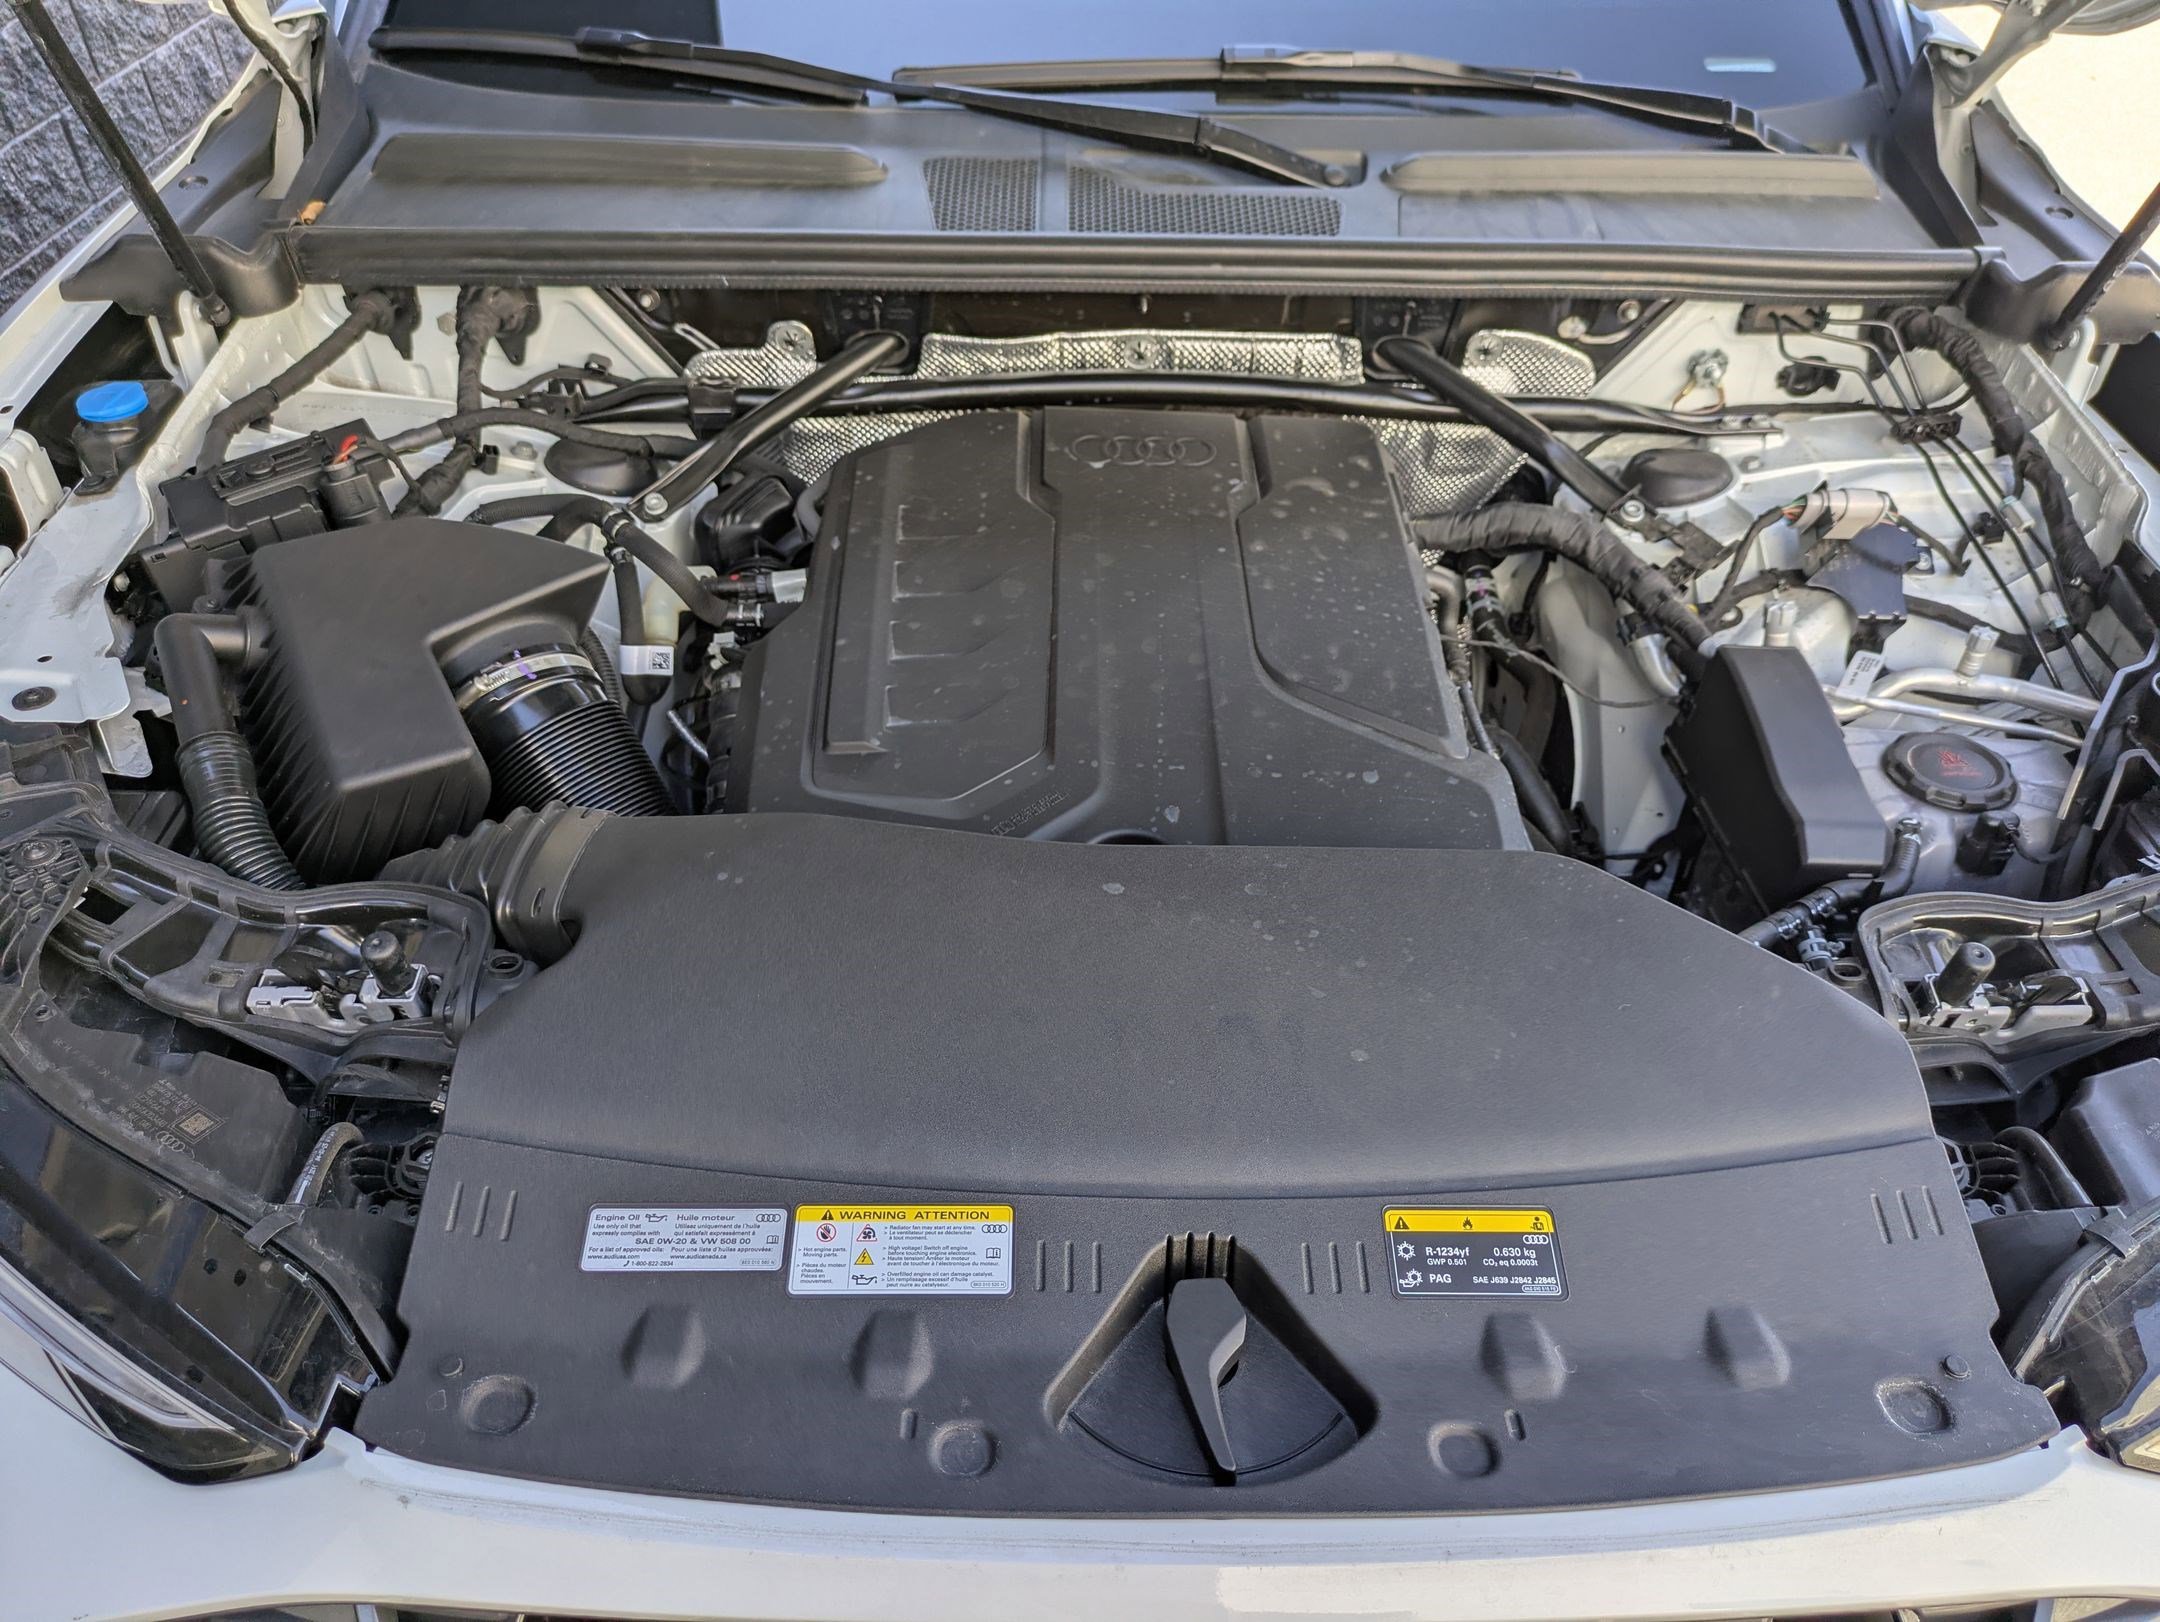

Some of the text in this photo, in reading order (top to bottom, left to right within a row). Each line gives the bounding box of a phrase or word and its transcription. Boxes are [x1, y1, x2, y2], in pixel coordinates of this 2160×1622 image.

[595, 1214, 625, 1222] Engine
[839, 1211, 990, 1220] WARNING ATTENTION
[1425, 1247, 1470, 1258] R-1234yf
[1493, 1247, 1536, 1259] 0.630 kg
[1427, 1258, 1467, 1266] GWP 0.501
[1429, 1274, 1452, 1283] PAG
[1472, 1276, 1557, 1284] SAE J639 J2842 J2845
